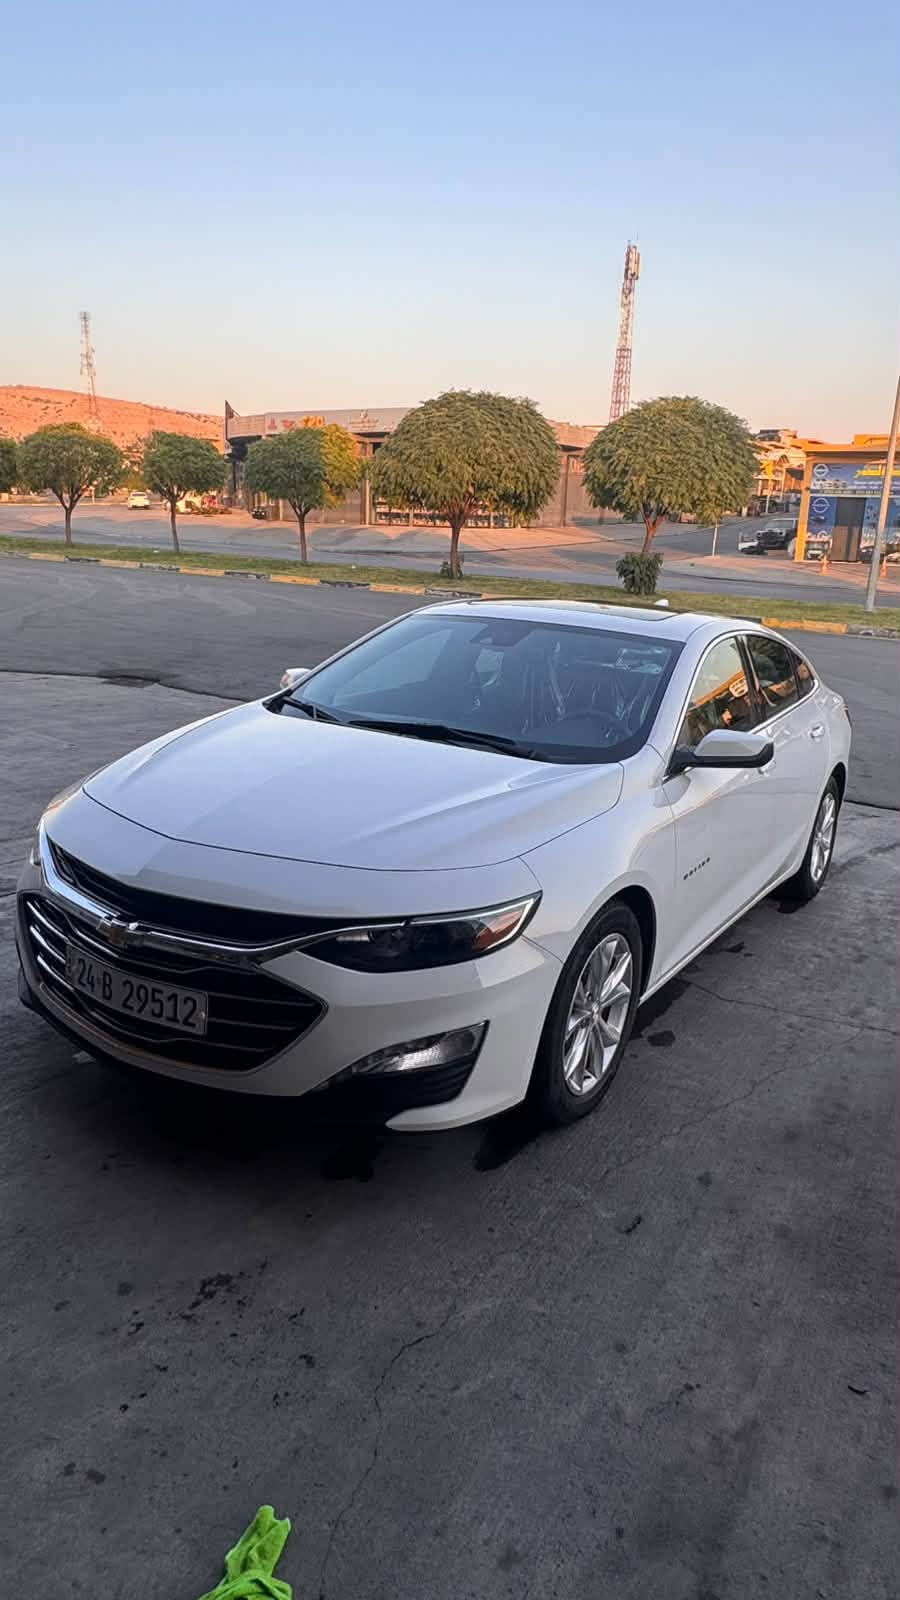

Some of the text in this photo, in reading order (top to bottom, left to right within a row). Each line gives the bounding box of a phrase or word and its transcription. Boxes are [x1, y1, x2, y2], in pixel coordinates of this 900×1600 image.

[78, 959, 95, 993] 24
[102, 971, 112, 1001] B
[121, 980, 198, 1028] 29512
